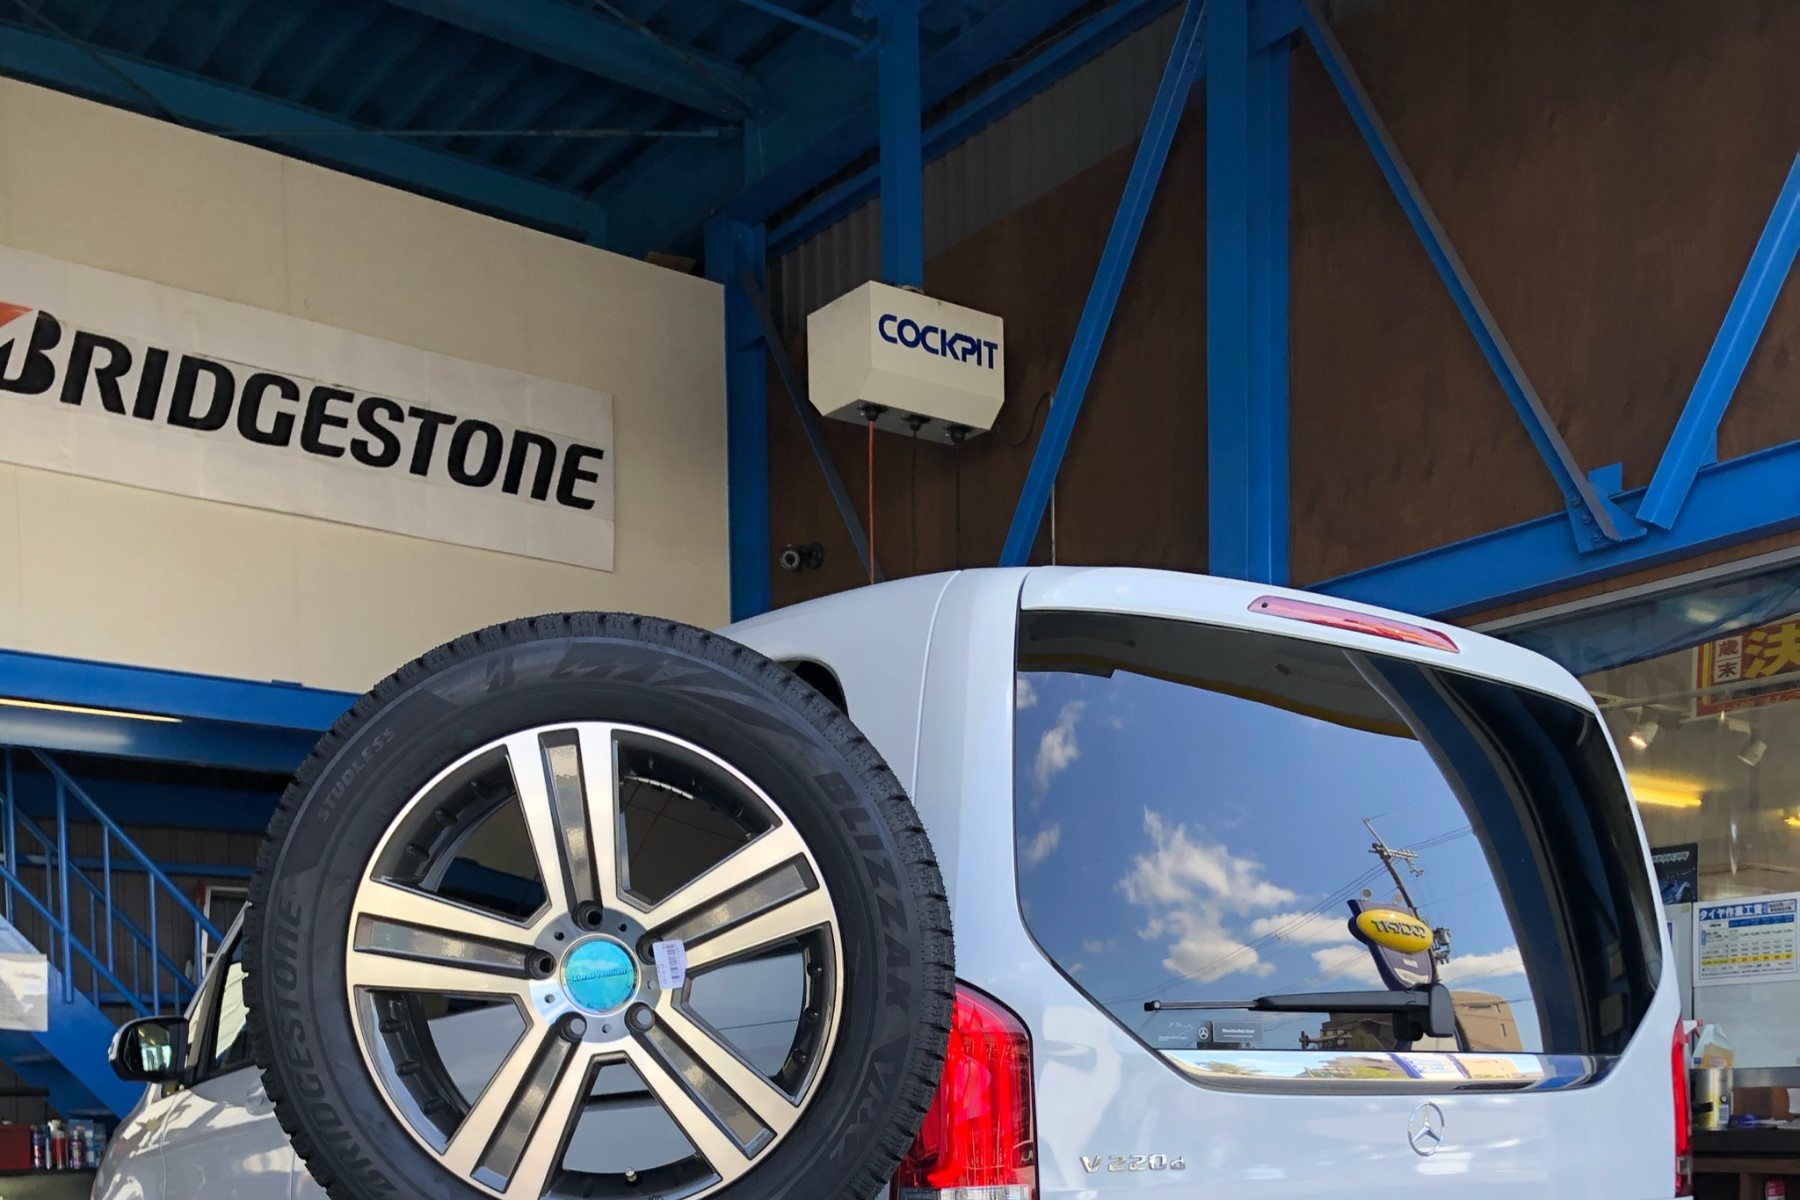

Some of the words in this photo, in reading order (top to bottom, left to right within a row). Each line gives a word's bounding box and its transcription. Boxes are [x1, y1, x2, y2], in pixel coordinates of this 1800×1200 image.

[0, 304, 605, 511] BRIDGESTONE
[878, 313, 999, 369] COCKPIT
[317, 727, 396, 824] STUDLESS
[814, 771, 912, 1016] BLIZZAK
[272, 899, 399, 1199] BRIDGESTONE
